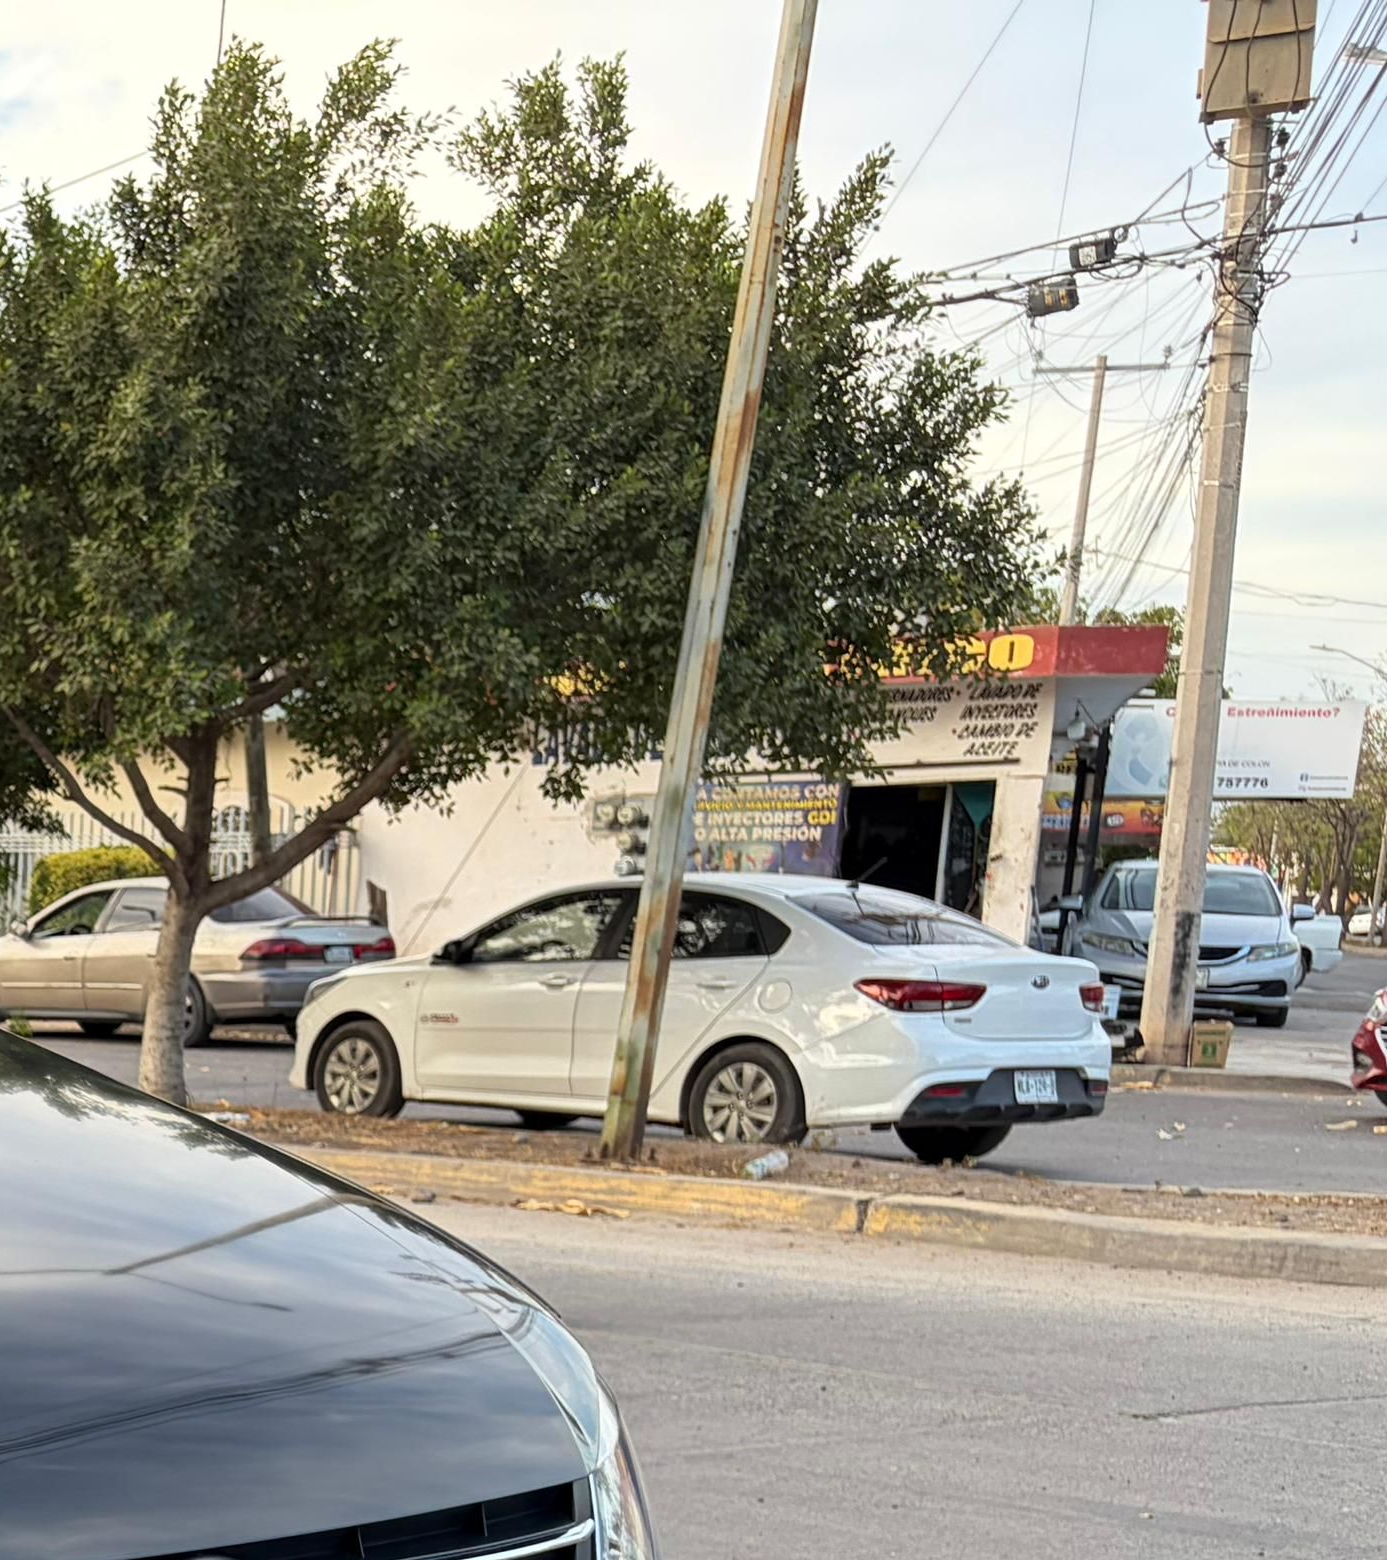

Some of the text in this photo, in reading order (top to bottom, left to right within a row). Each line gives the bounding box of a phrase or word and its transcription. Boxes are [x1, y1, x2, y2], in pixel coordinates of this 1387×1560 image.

[969, 682, 1043, 700] LAVADO DE
[959, 702, 1038, 720] INYECTORES
[1227, 706, 1340, 718] Estreñimiento?
[957, 721, 1039, 740] CAMBIO DE
[963, 741, 1019, 756] ACEITE
[712, 785, 801, 800] CONTAMOS
[804, 783, 840, 799] CON
[708, 810, 803, 826] INYECTORES
[709, 827, 748, 841] ALTA
[752, 825, 822, 841] PRESIÓN
